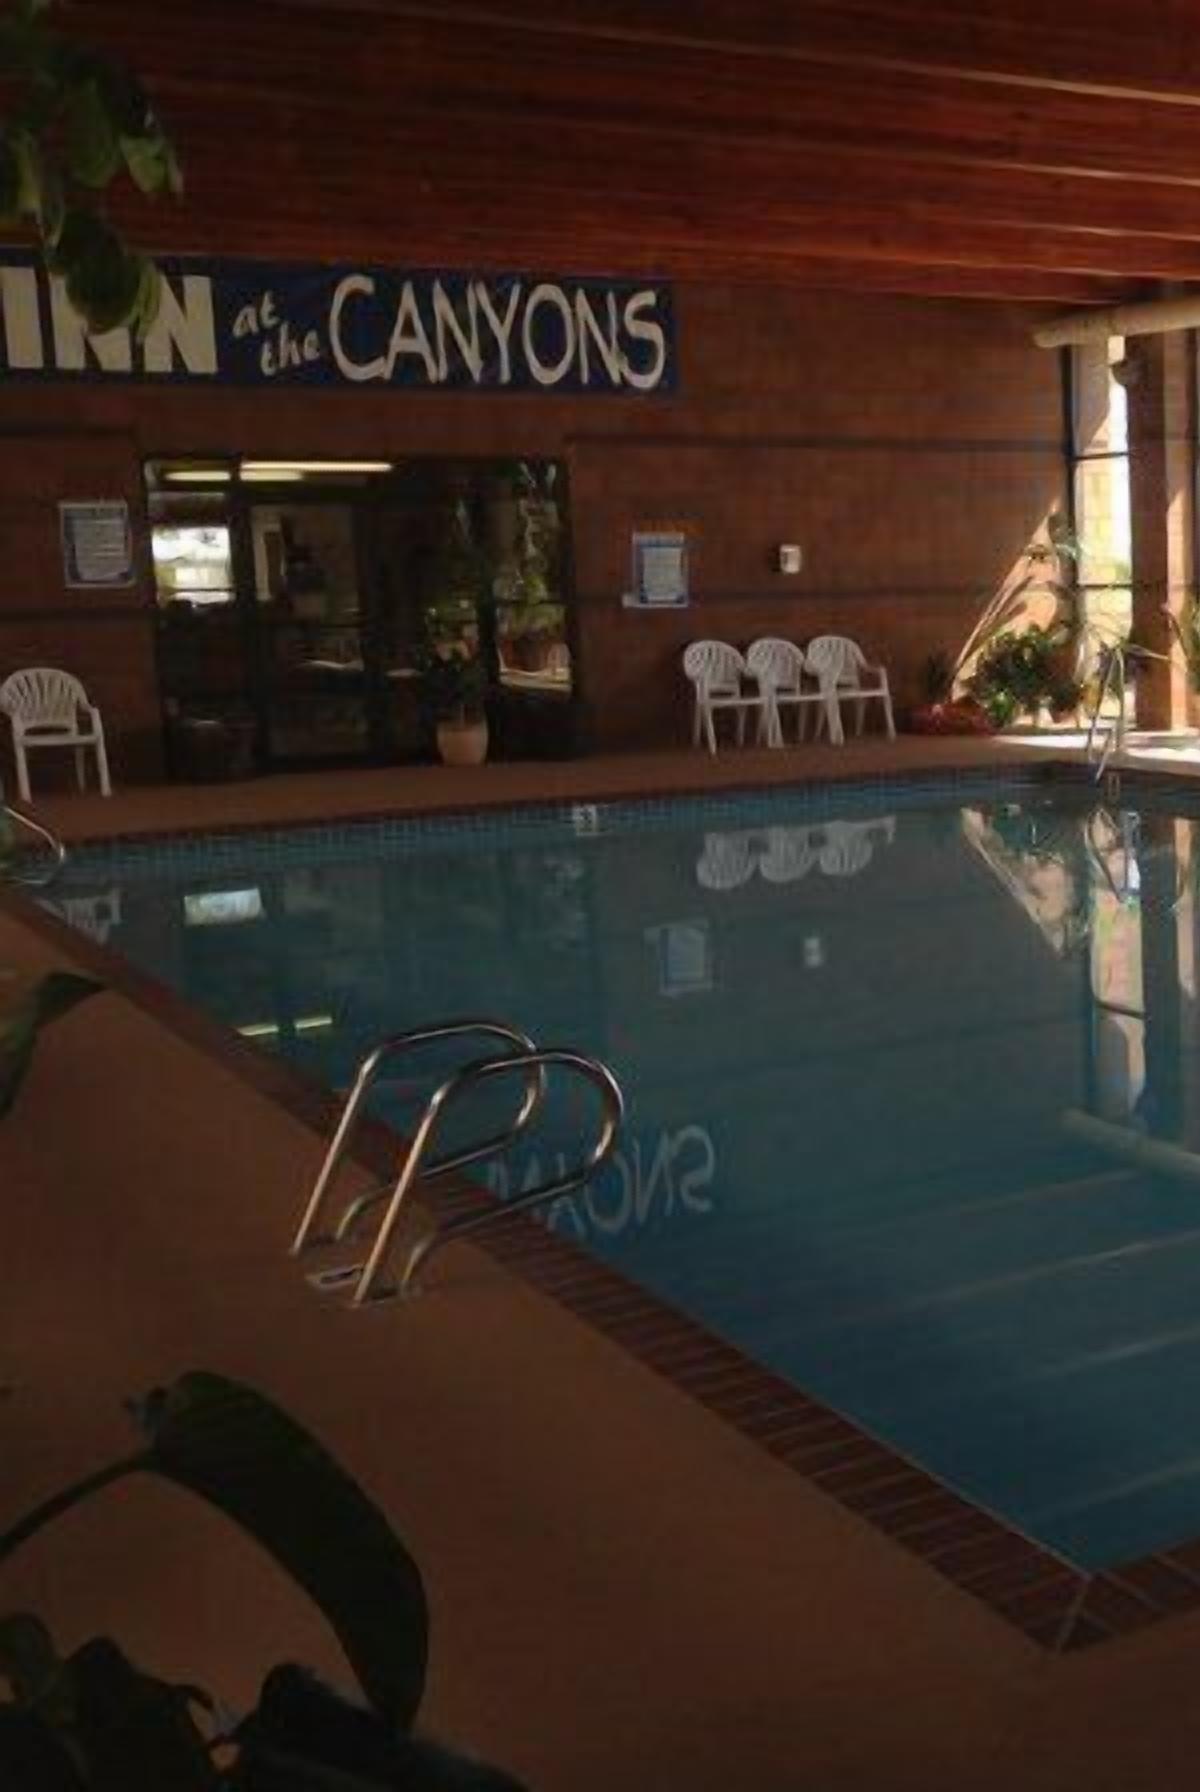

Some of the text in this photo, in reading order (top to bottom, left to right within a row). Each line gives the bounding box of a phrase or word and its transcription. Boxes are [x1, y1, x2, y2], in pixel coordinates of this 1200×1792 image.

[233, 291, 281, 337] at
[260, 321, 320, 376] the
[329, 273, 665, 388] CANYONS
